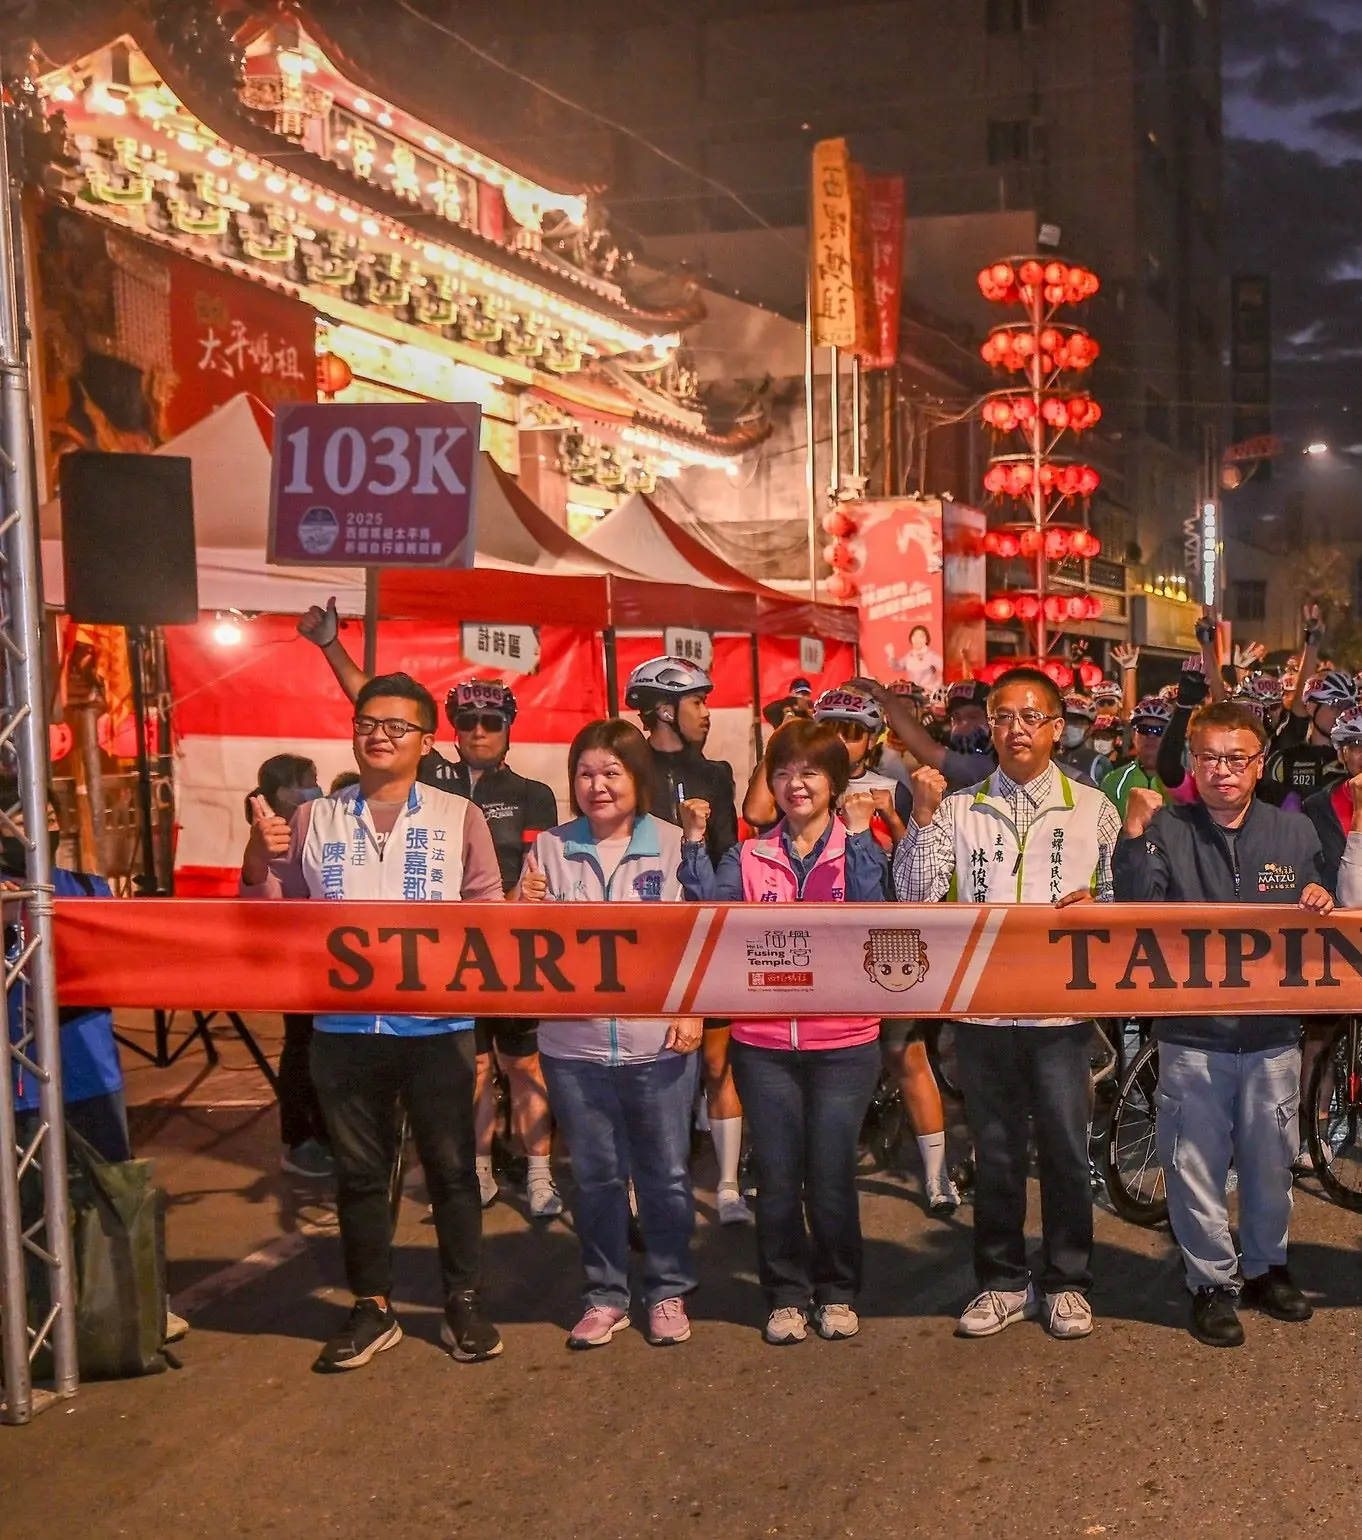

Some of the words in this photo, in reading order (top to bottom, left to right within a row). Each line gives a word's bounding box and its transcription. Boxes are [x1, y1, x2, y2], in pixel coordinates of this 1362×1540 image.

[198, 320, 305, 380] 太平媽祖
[284, 426, 468, 496] 103K
[346, 512, 383, 526] 2025
[825, 692, 862, 709] 0282
[1293, 775, 1315, 786] 2021
[993, 833, 1004, 863] 主席
[1259, 874, 1295, 883] MATZU
[326, 926, 638, 993] START
[747, 949, 785, 958] Fusing
[748, 958, 792, 967] Temple
